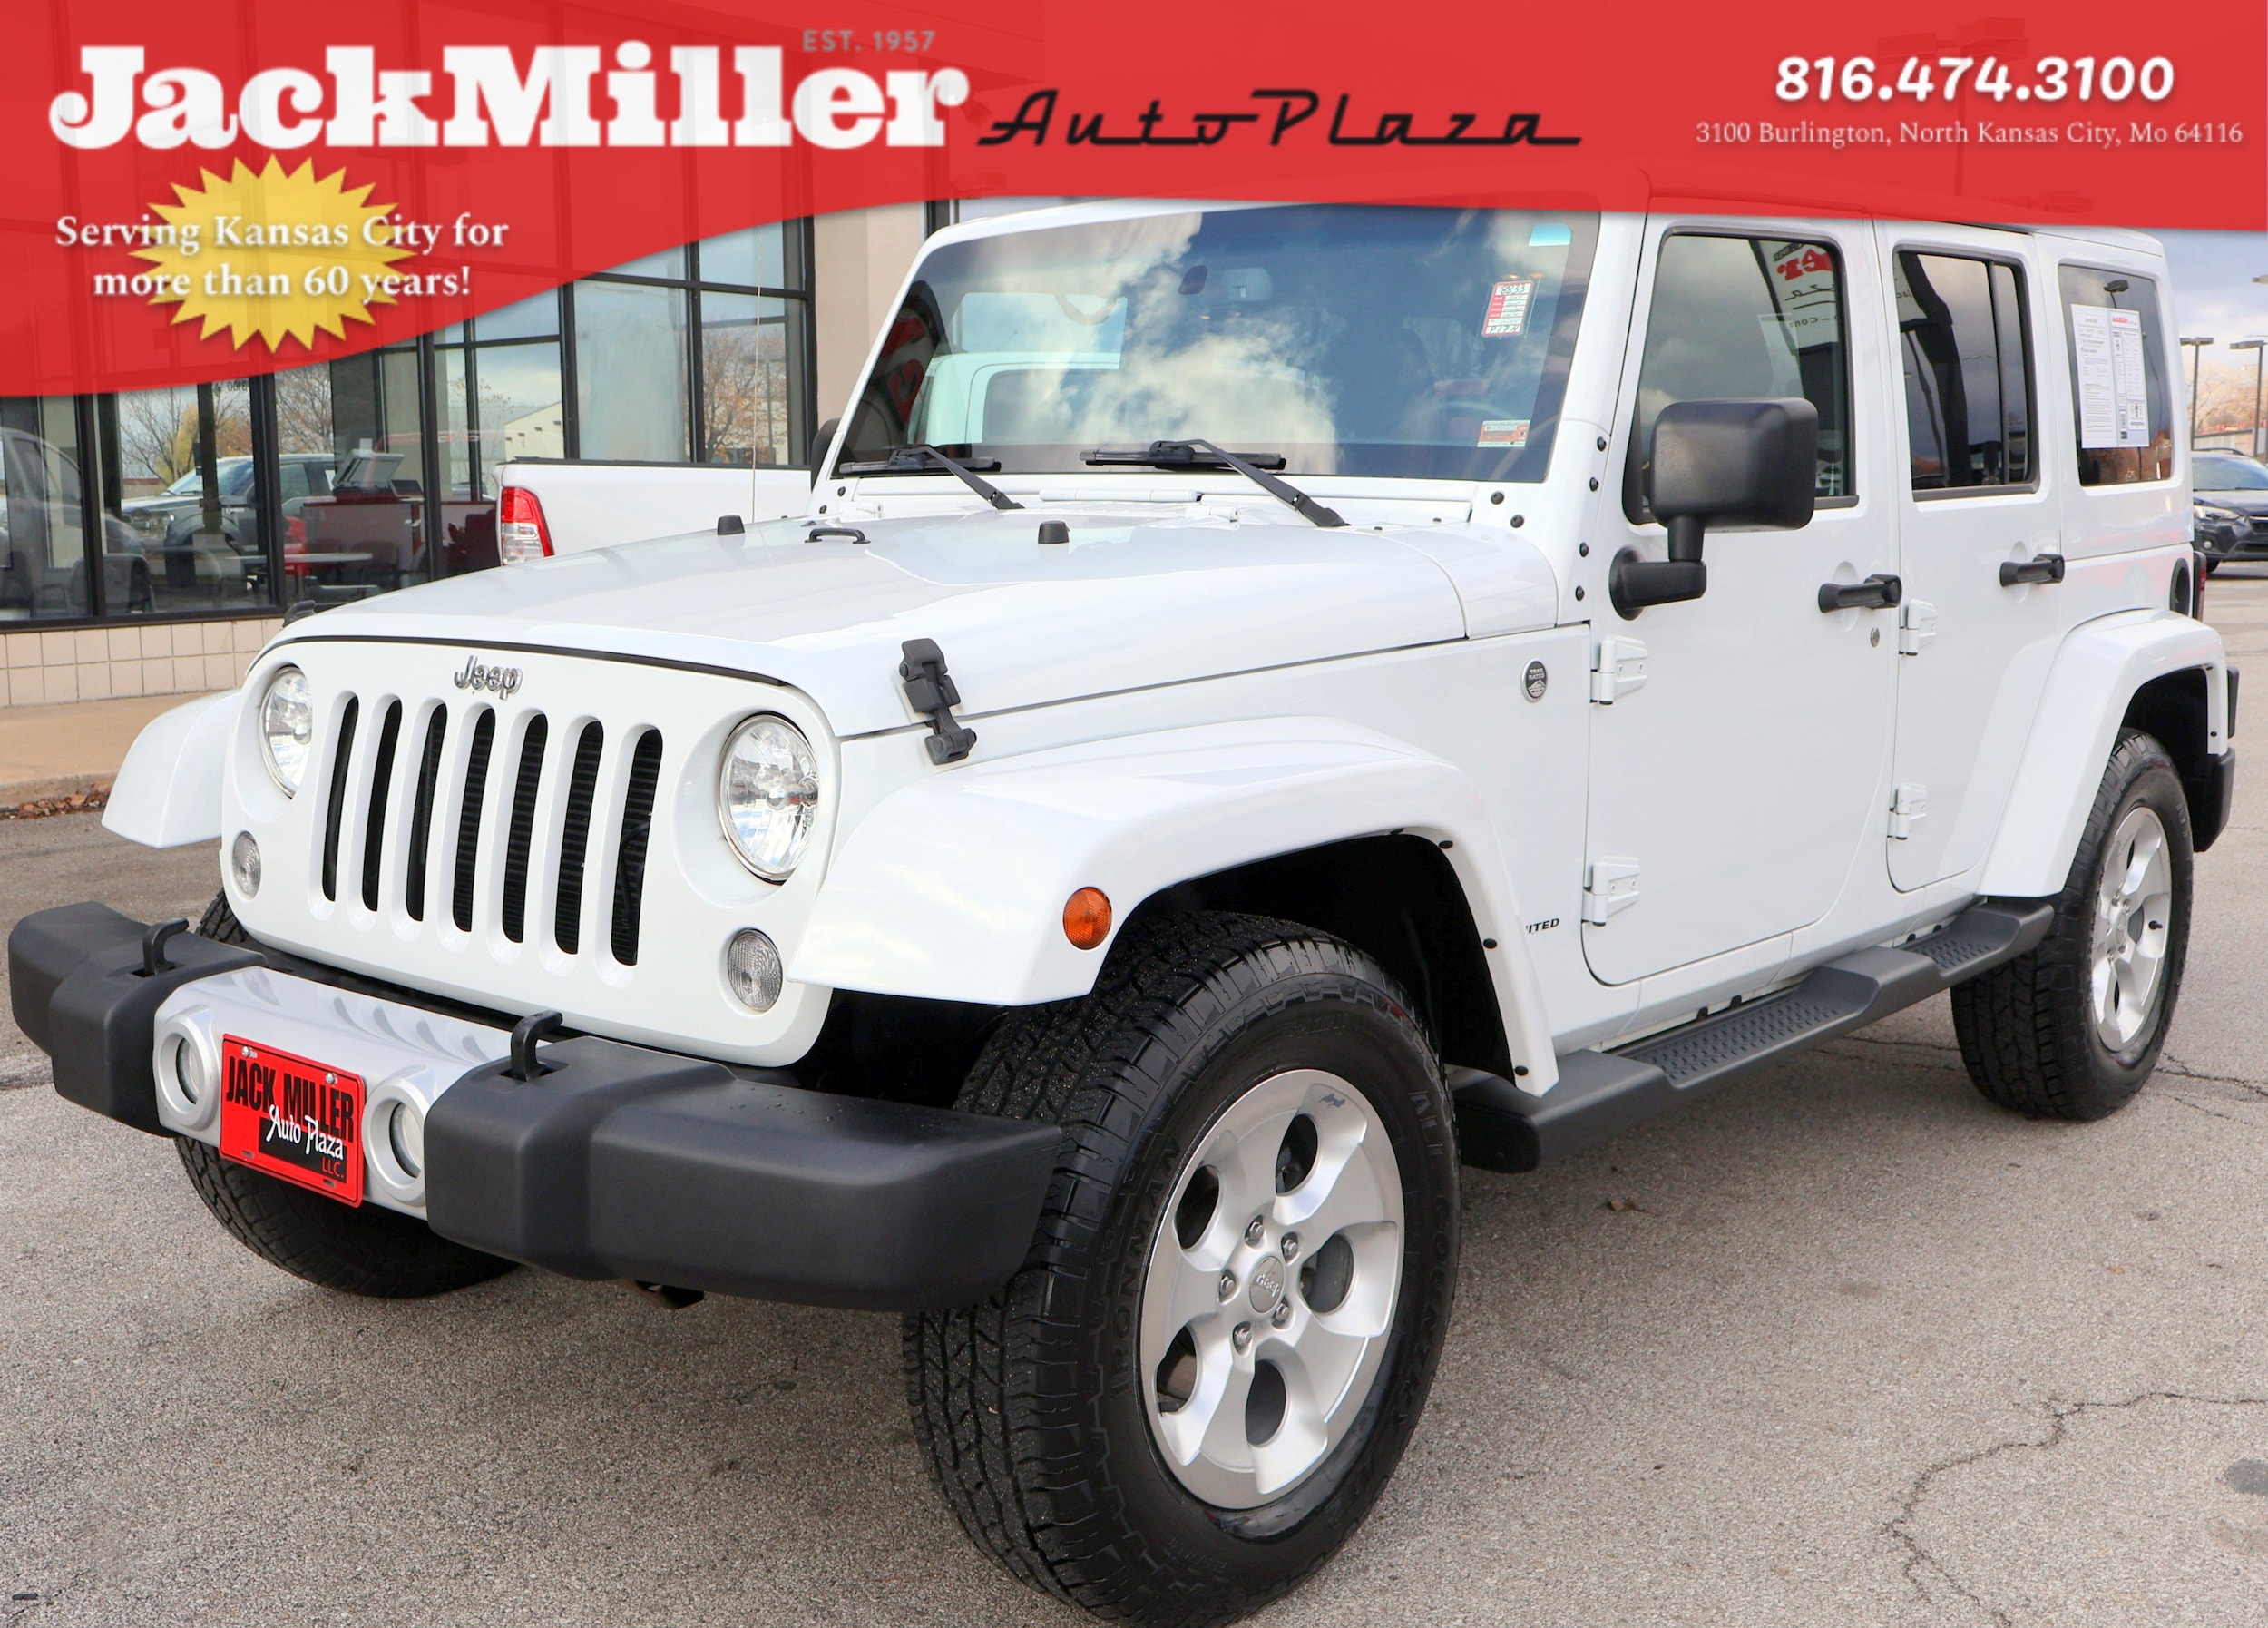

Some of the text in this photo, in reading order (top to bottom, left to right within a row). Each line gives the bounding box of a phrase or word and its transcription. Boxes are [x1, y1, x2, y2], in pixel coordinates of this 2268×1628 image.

[454, 654, 523, 701] Jeep
[1525, 917, 1560, 934] ITED
[226, 1055, 355, 1143] JACK MILLER
[266, 1103, 344, 1161] Auto Plaza
